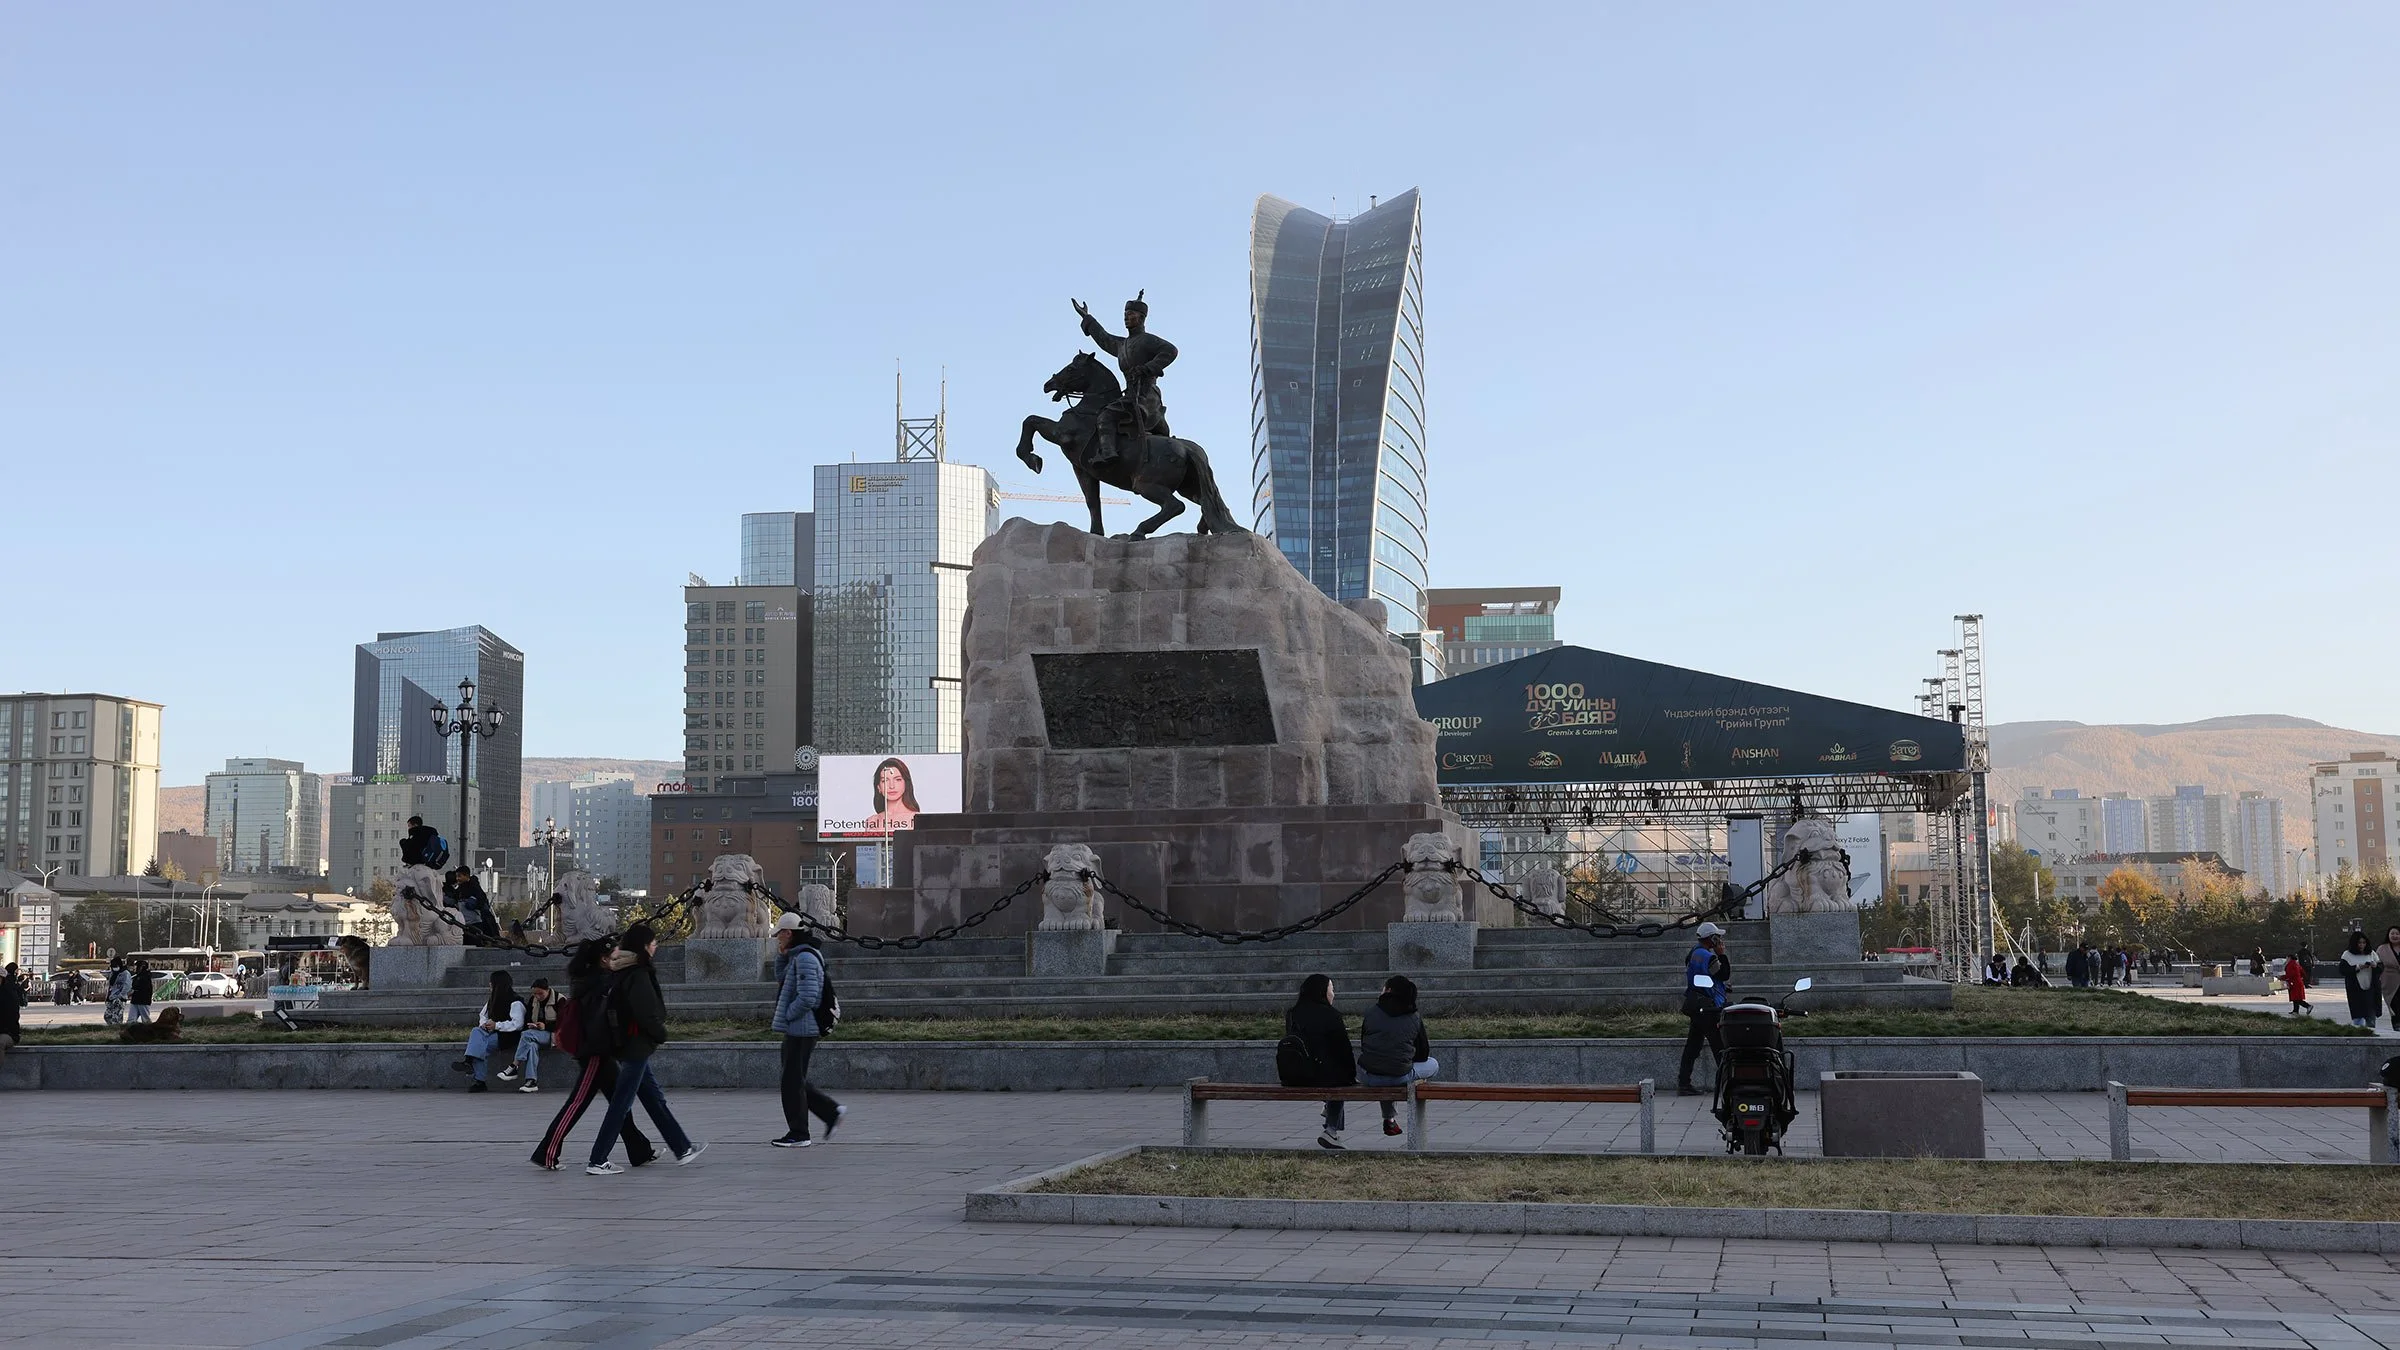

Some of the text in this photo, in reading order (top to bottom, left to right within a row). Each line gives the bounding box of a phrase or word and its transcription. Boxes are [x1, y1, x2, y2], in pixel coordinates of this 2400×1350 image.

[375, 646, 420, 654] MONCON
[503, 651, 523, 661] MONCON
[1525, 683, 1584, 700] 1000
[1664, 706, 1790, 718] Үндэсний брэнд бүтээгч
[1432, 716, 1482, 730] GROUP
[1562, 711, 1616, 725] БАЯР
[1547, 728, 1574, 736] Gremix
[1732, 748, 1779, 758] ANSHAN
[1890, 744, 1920, 756] Затея
[1442, 752, 1493, 768] Сакура
[1818, 752, 1857, 762] АРАВНАЙ
[336, 776, 365, 784] ЗОЧИД
[824, 819, 880, 830] Potential
[883, 819, 908, 829] Has
